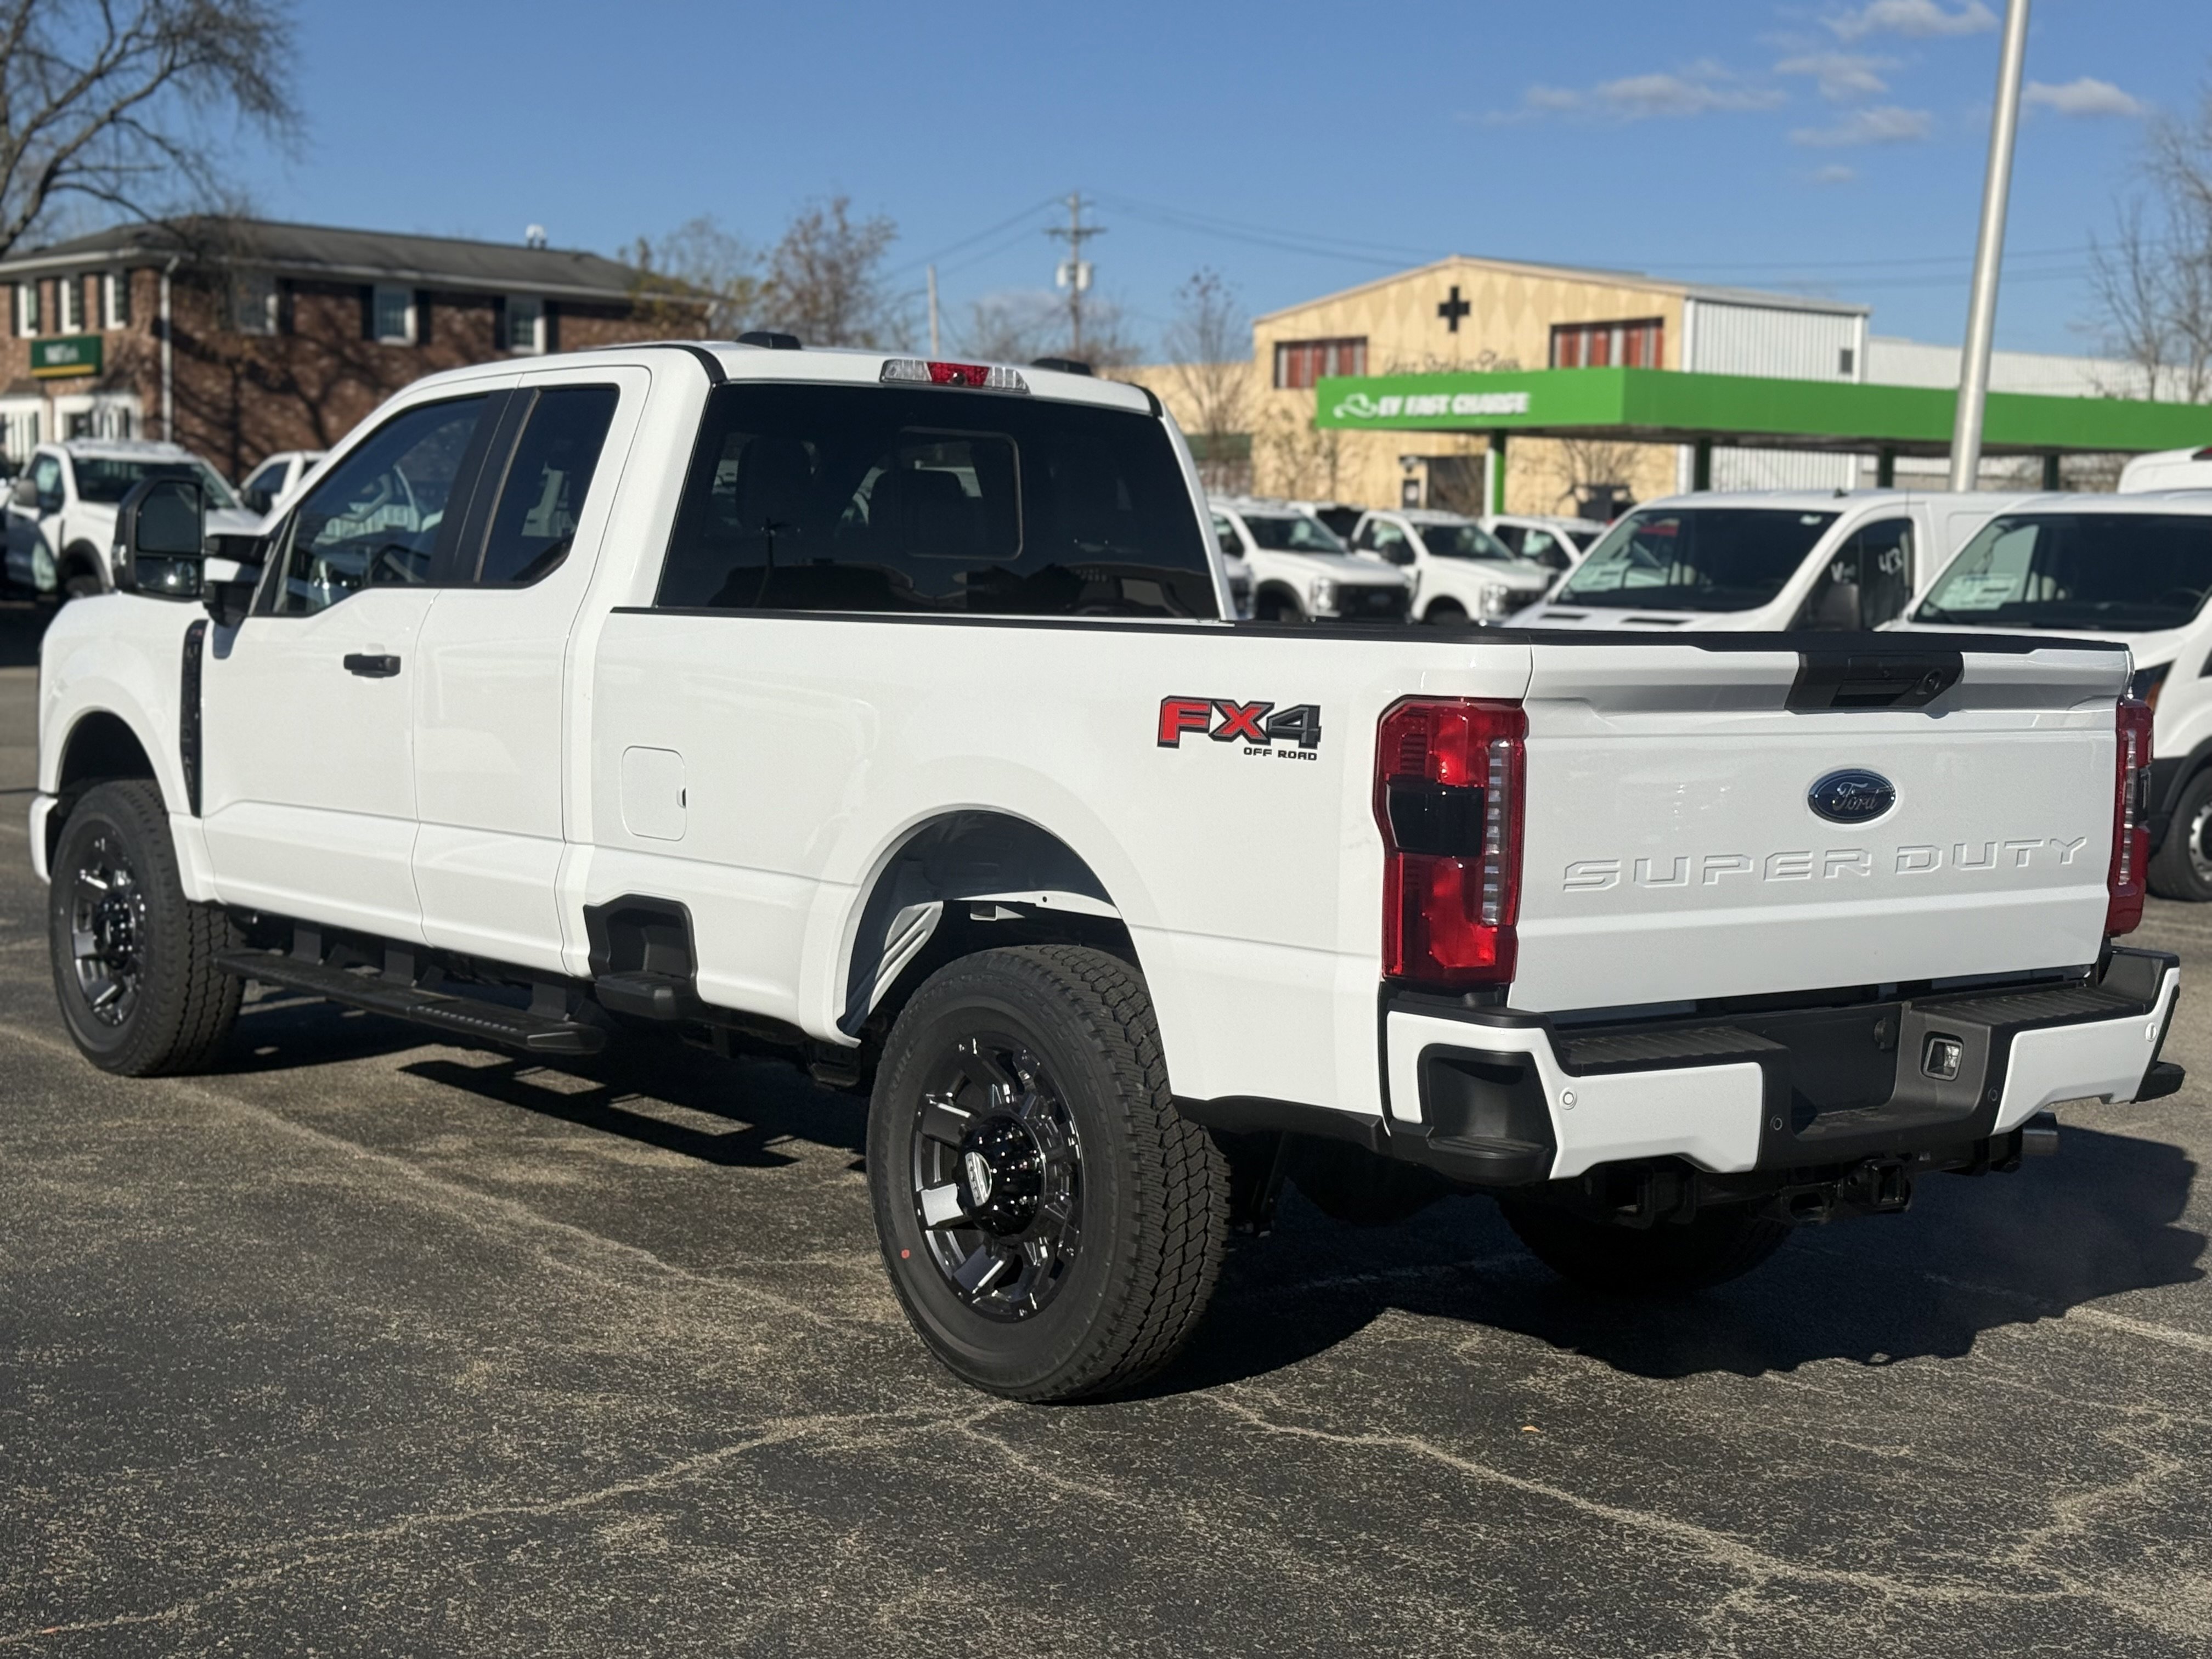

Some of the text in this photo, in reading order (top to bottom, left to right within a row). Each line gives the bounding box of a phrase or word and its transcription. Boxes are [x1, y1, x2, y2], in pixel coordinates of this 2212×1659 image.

[1157, 695, 1321, 749] FX4
[1243, 747, 1317, 761] OFF ROAD
[1832, 782, 1879, 811] Ford
[1564, 837, 2087, 891] SUPER DUTY
